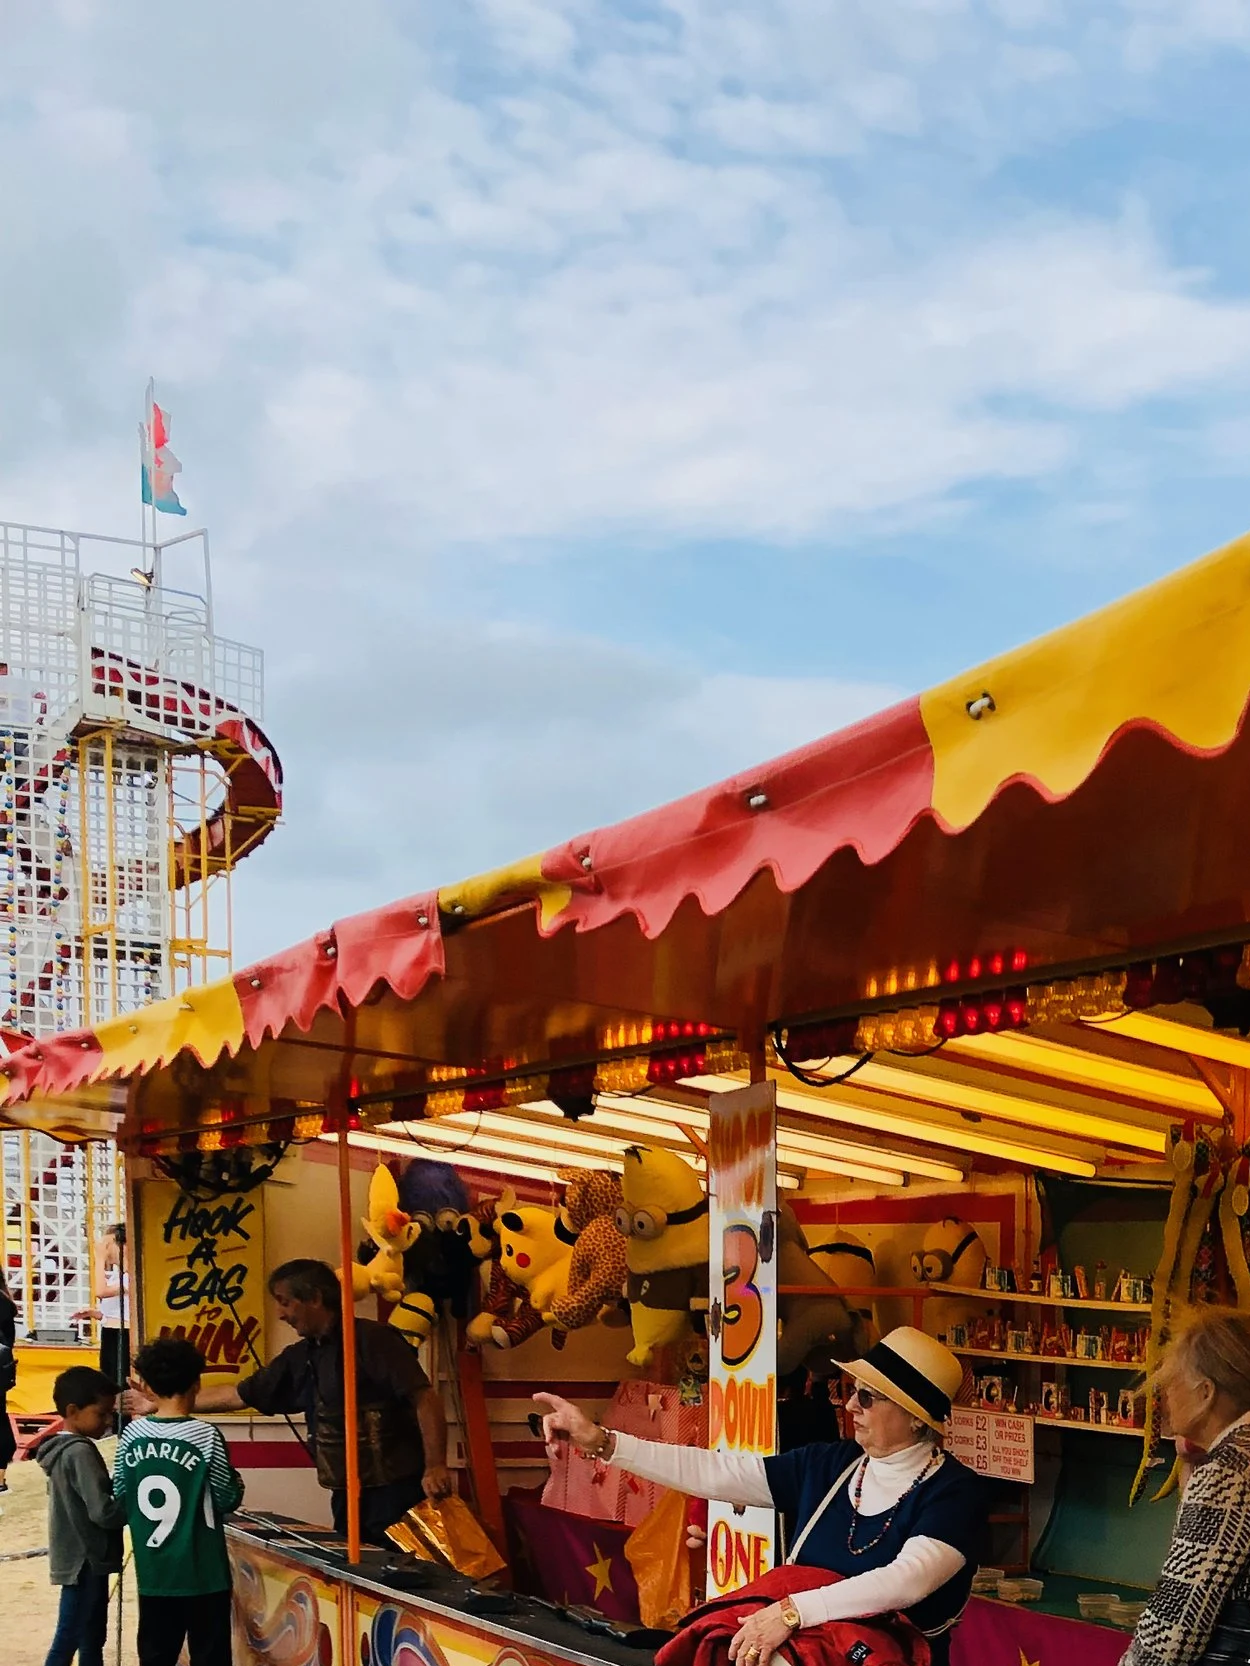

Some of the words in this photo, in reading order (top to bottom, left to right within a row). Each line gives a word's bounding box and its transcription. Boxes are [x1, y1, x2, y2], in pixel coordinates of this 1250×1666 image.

[163, 1197, 254, 1243] HOOK
[187, 1237, 218, 1268] A
[166, 1264, 248, 1311] BAG
[721, 1221, 763, 1371] 3
[710, 1374, 776, 1451] DOWN
[954, 1416, 974, 1426] CORKS
[976, 1415, 987, 1432] £2
[994, 1418, 1006, 1428] WIN
[1008, 1420, 1025, 1430] CASH
[954, 1436, 974, 1446] CORKS
[976, 1434, 988, 1450] £3
[994, 1430, 1004, 1440] OR
[1005, 1432, 1026, 1443] PRIZES
[125, 1442, 202, 1472] CHARLIE
[976, 1454, 988, 1470] £5
[137, 1475, 182, 1548] 9
[710, 1518, 771, 1594] ONE
